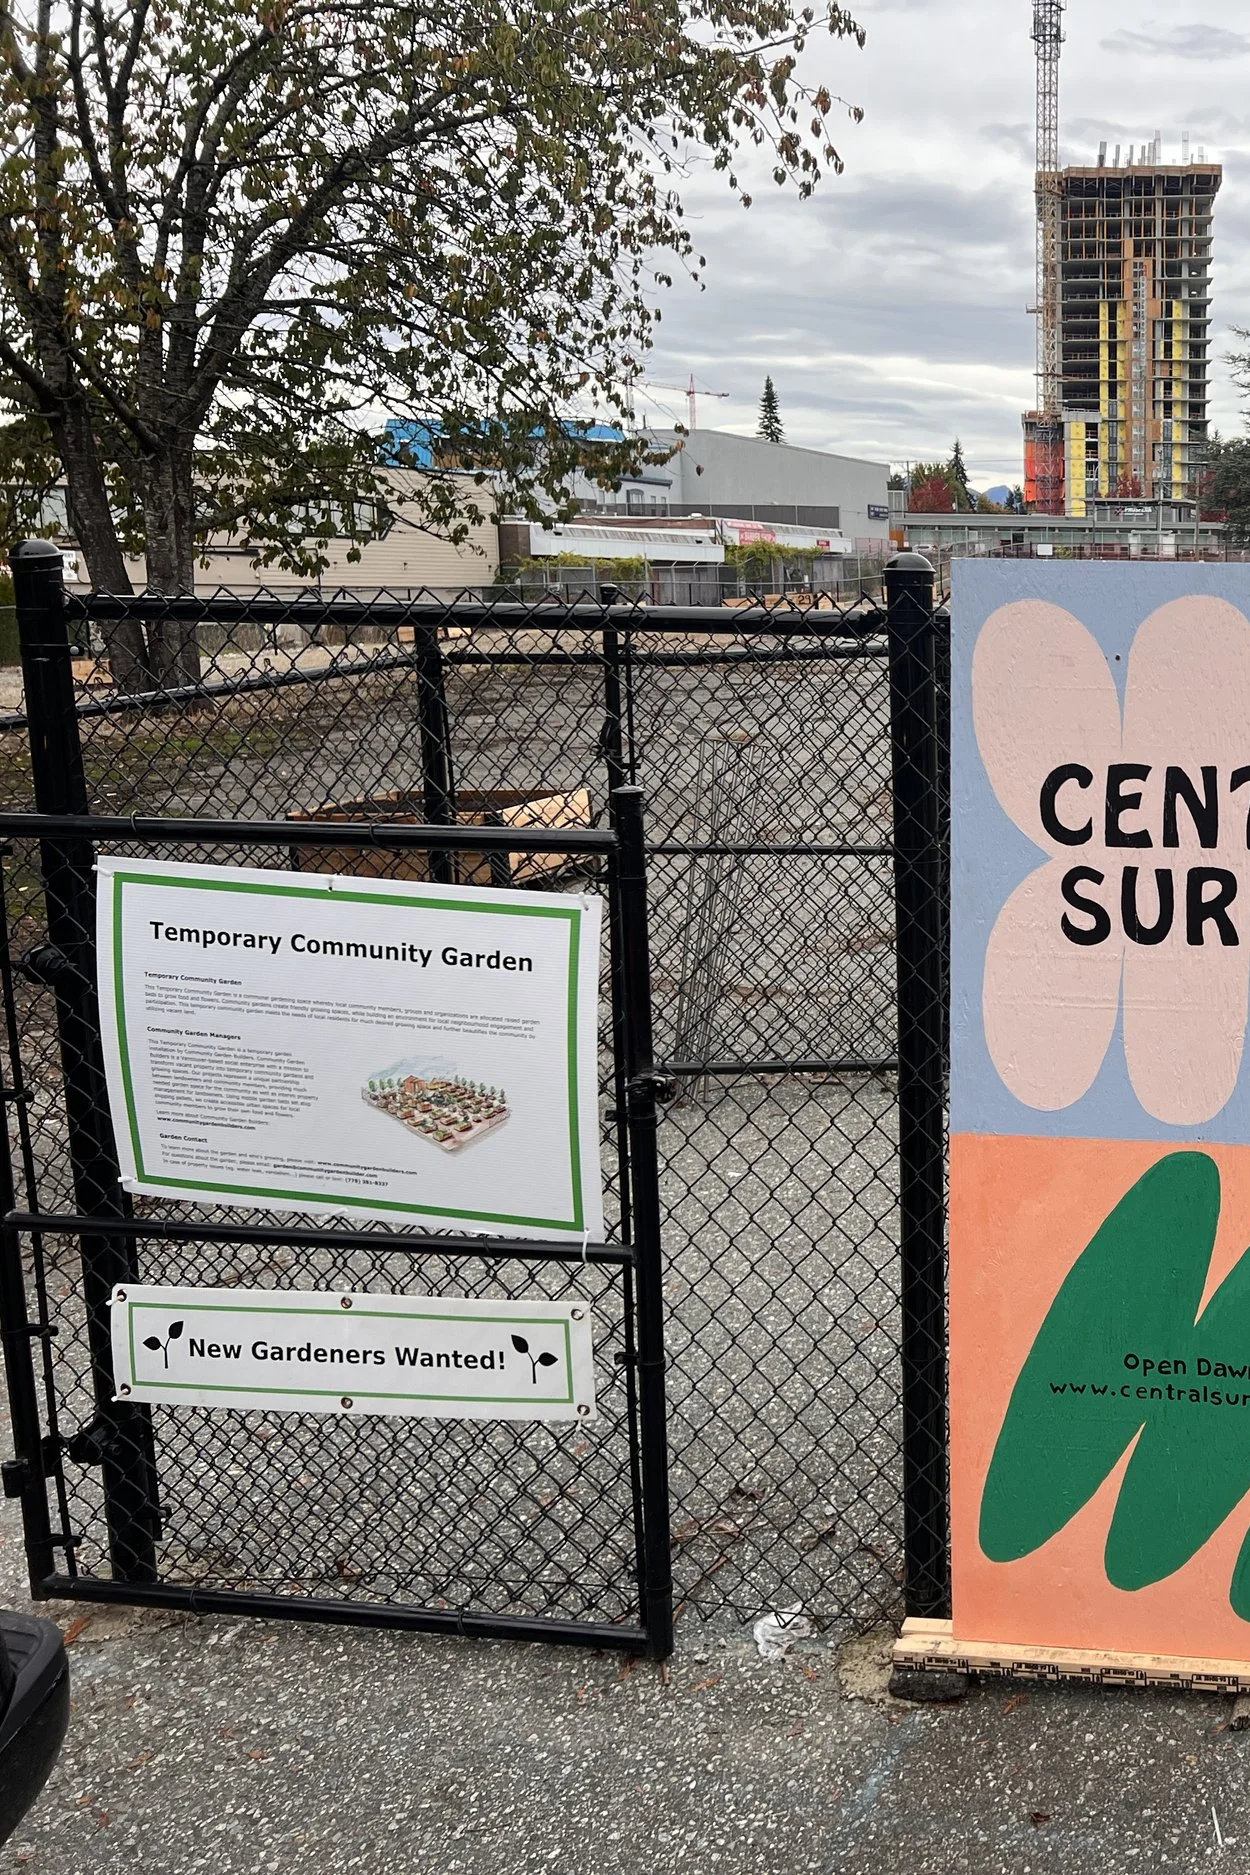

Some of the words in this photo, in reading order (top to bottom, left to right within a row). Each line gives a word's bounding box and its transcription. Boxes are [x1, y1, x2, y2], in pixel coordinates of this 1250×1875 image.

[798, 594, 812, 605] 29
[150, 921, 282, 955] Temporary
[291, 934, 433, 968] Community
[442, 947, 534, 972] Garden
[145, 971, 179, 981] Temporary
[180, 974, 217, 984] Community
[184, 988, 212, 996] Community
[271, 996, 296, 1004] gardening
[348, 1003, 377, 1011] community
[217, 1005, 245, 1013] community
[395, 1021, 415, 1029] growing
[499, 1031, 527, 1039] community
[222, 998, 250, 1006] Community
[310, 1006, 330, 1014] growing
[395, 1014, 427, 1022] environment
[490, 1023, 522, 1031] engagement
[147, 1026, 183, 1036] Community
[210, 1032, 241, 1041] Managers
[183, 1135, 208, 1143] Contact
[190, 1338, 243, 1360] New
[252, 1341, 387, 1365] Gardeners
[395, 1347, 506, 1370] Wanted!
[1124, 1353, 1187, 1377] Open
